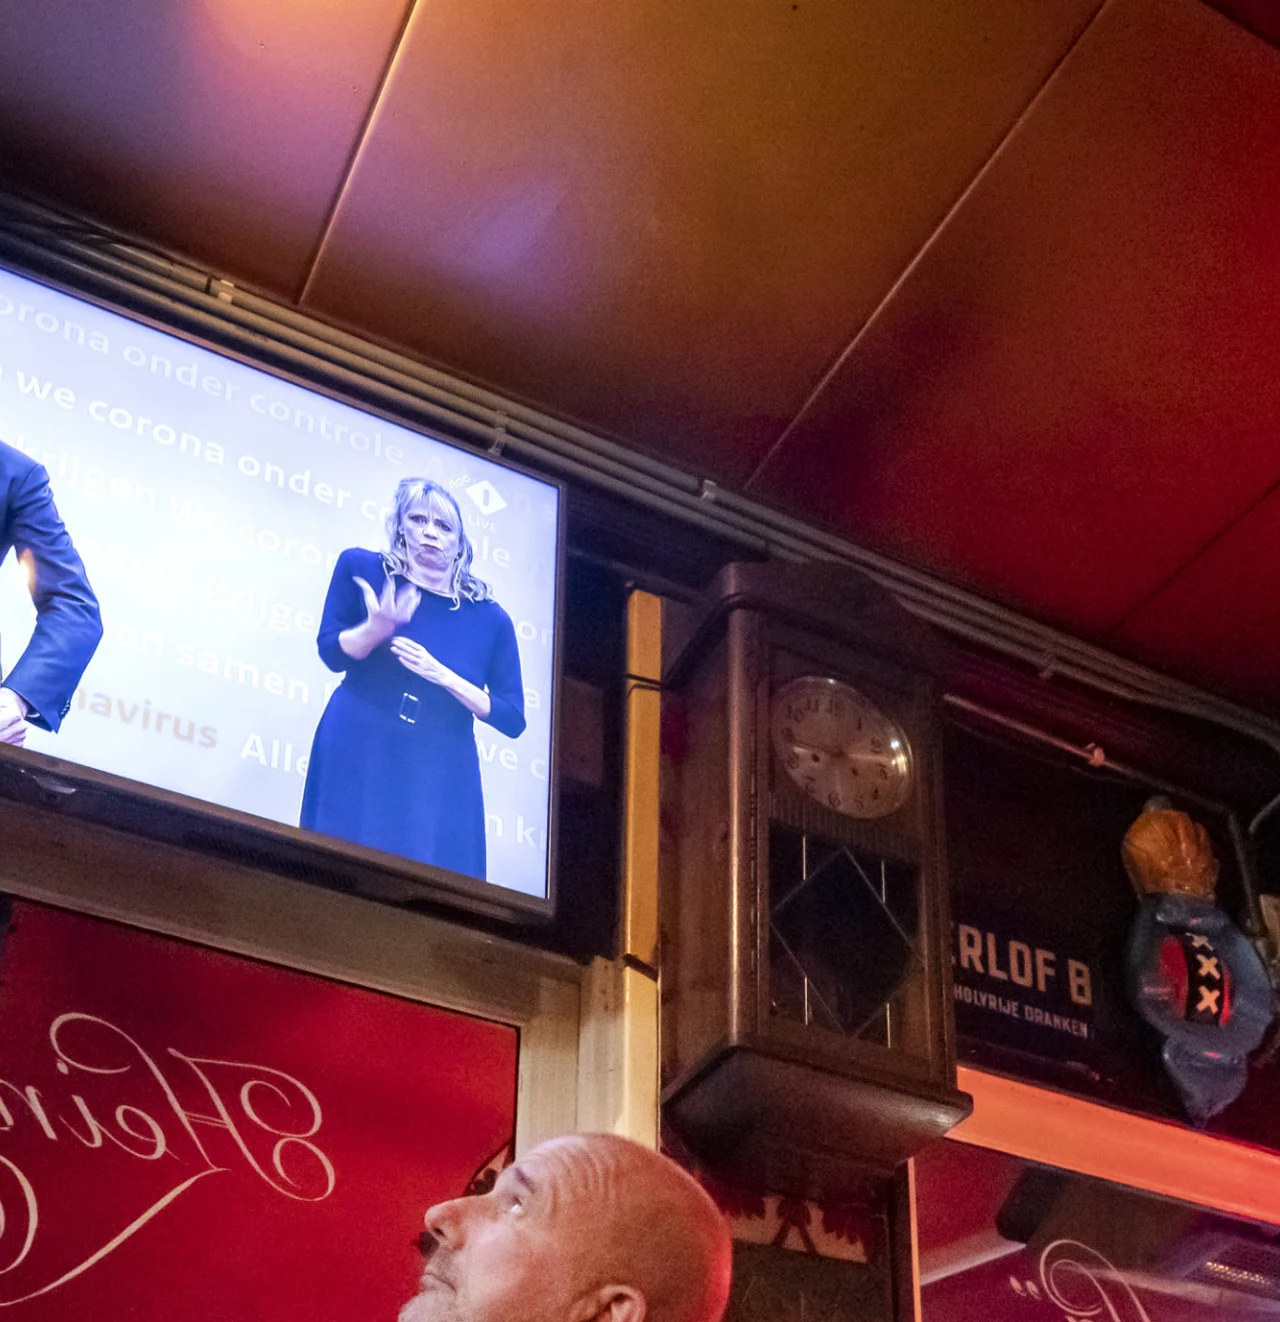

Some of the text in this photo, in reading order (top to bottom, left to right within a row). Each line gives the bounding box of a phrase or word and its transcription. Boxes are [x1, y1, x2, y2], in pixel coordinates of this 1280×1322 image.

[16, 369, 77, 410] we
[88, 400, 225, 468] corona
[237, 453, 352, 510] onder
[123, 342, 241, 403] onder
[249, 388, 407, 467] controle
[176, 642, 310, 705] samen
